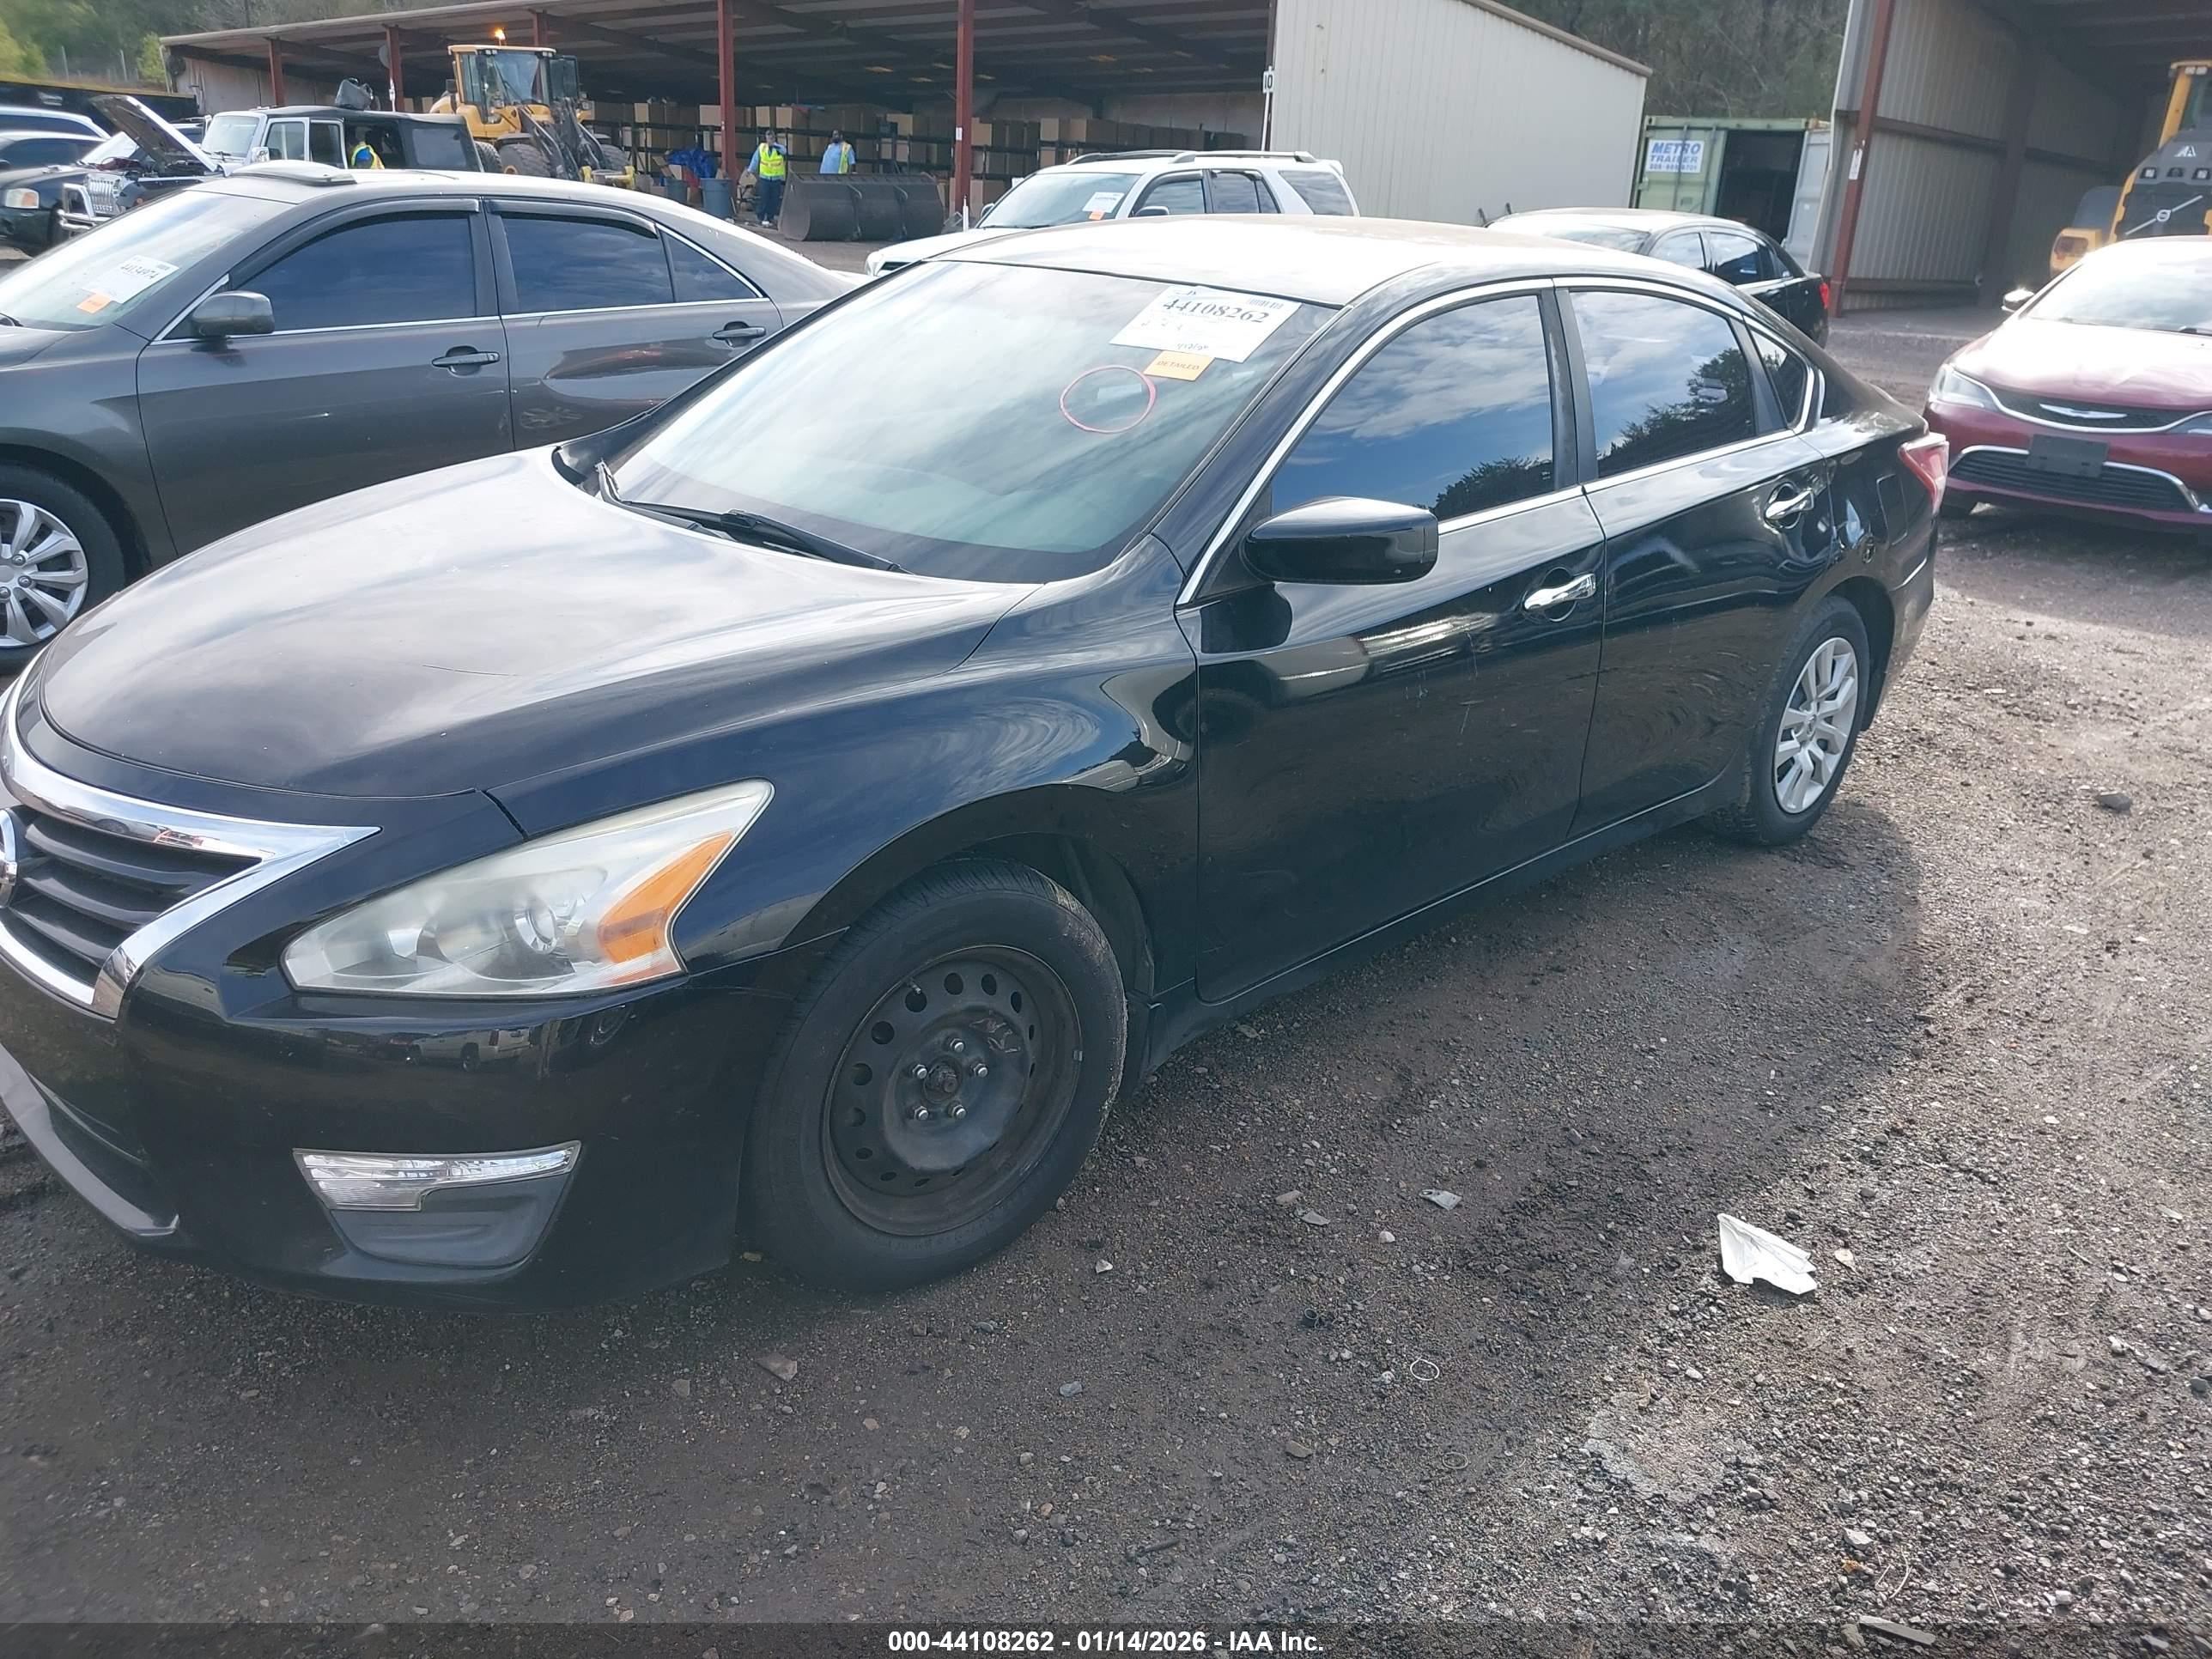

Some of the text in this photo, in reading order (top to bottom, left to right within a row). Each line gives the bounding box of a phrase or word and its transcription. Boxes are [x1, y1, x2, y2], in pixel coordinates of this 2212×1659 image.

[1651, 142, 1702, 155] METRO
[1163, 298, 1270, 323] 44108262
[1156, 360, 1200, 370] DETAILED
